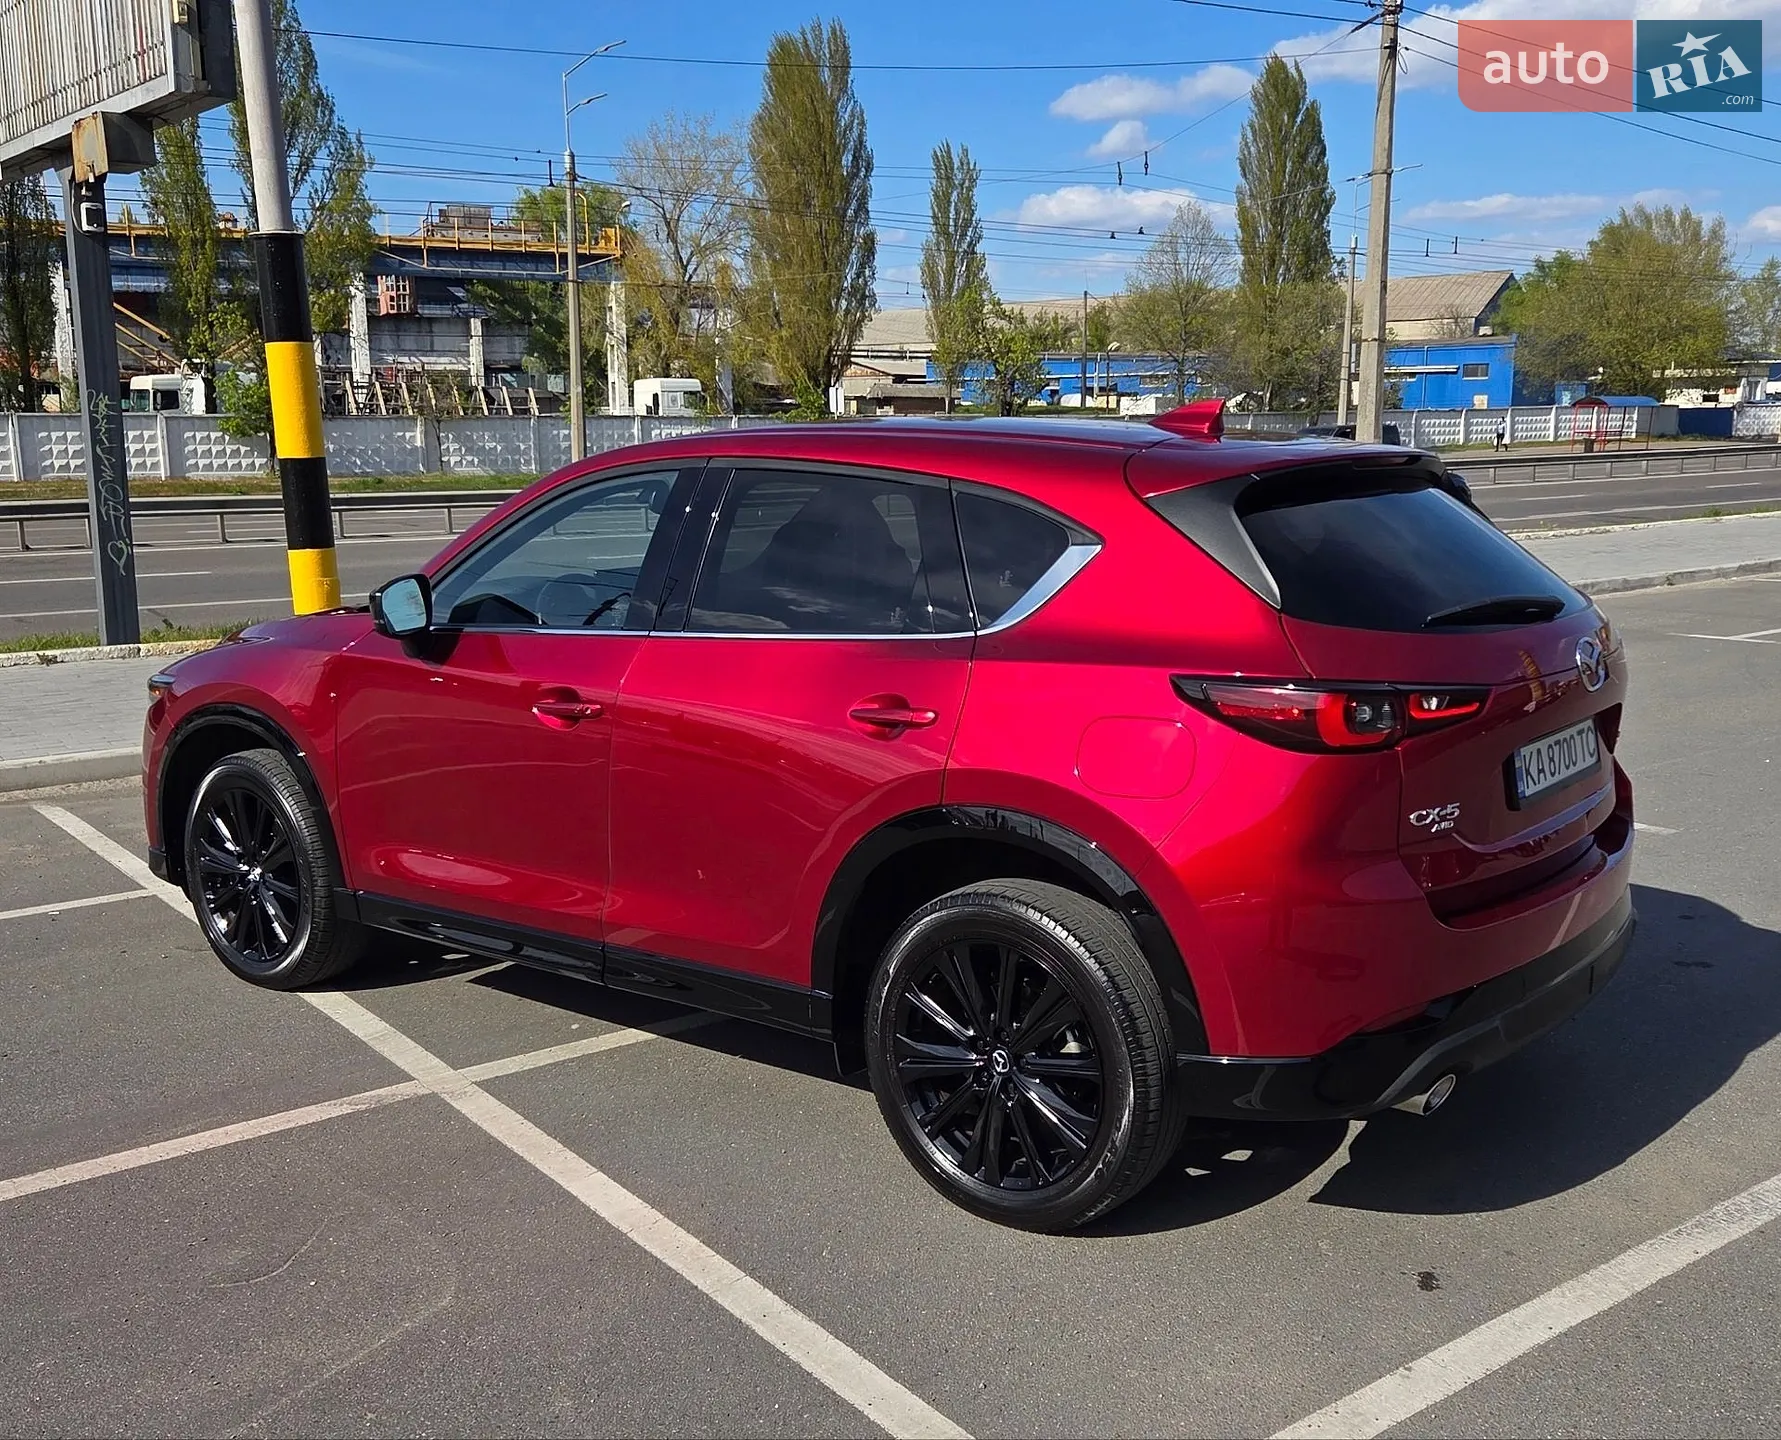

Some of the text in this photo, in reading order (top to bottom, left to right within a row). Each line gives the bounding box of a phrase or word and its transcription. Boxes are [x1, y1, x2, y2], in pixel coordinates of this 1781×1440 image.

[1523, 725, 1597, 789] KA 8700 TC
[1409, 803, 1460, 826] CX-5
